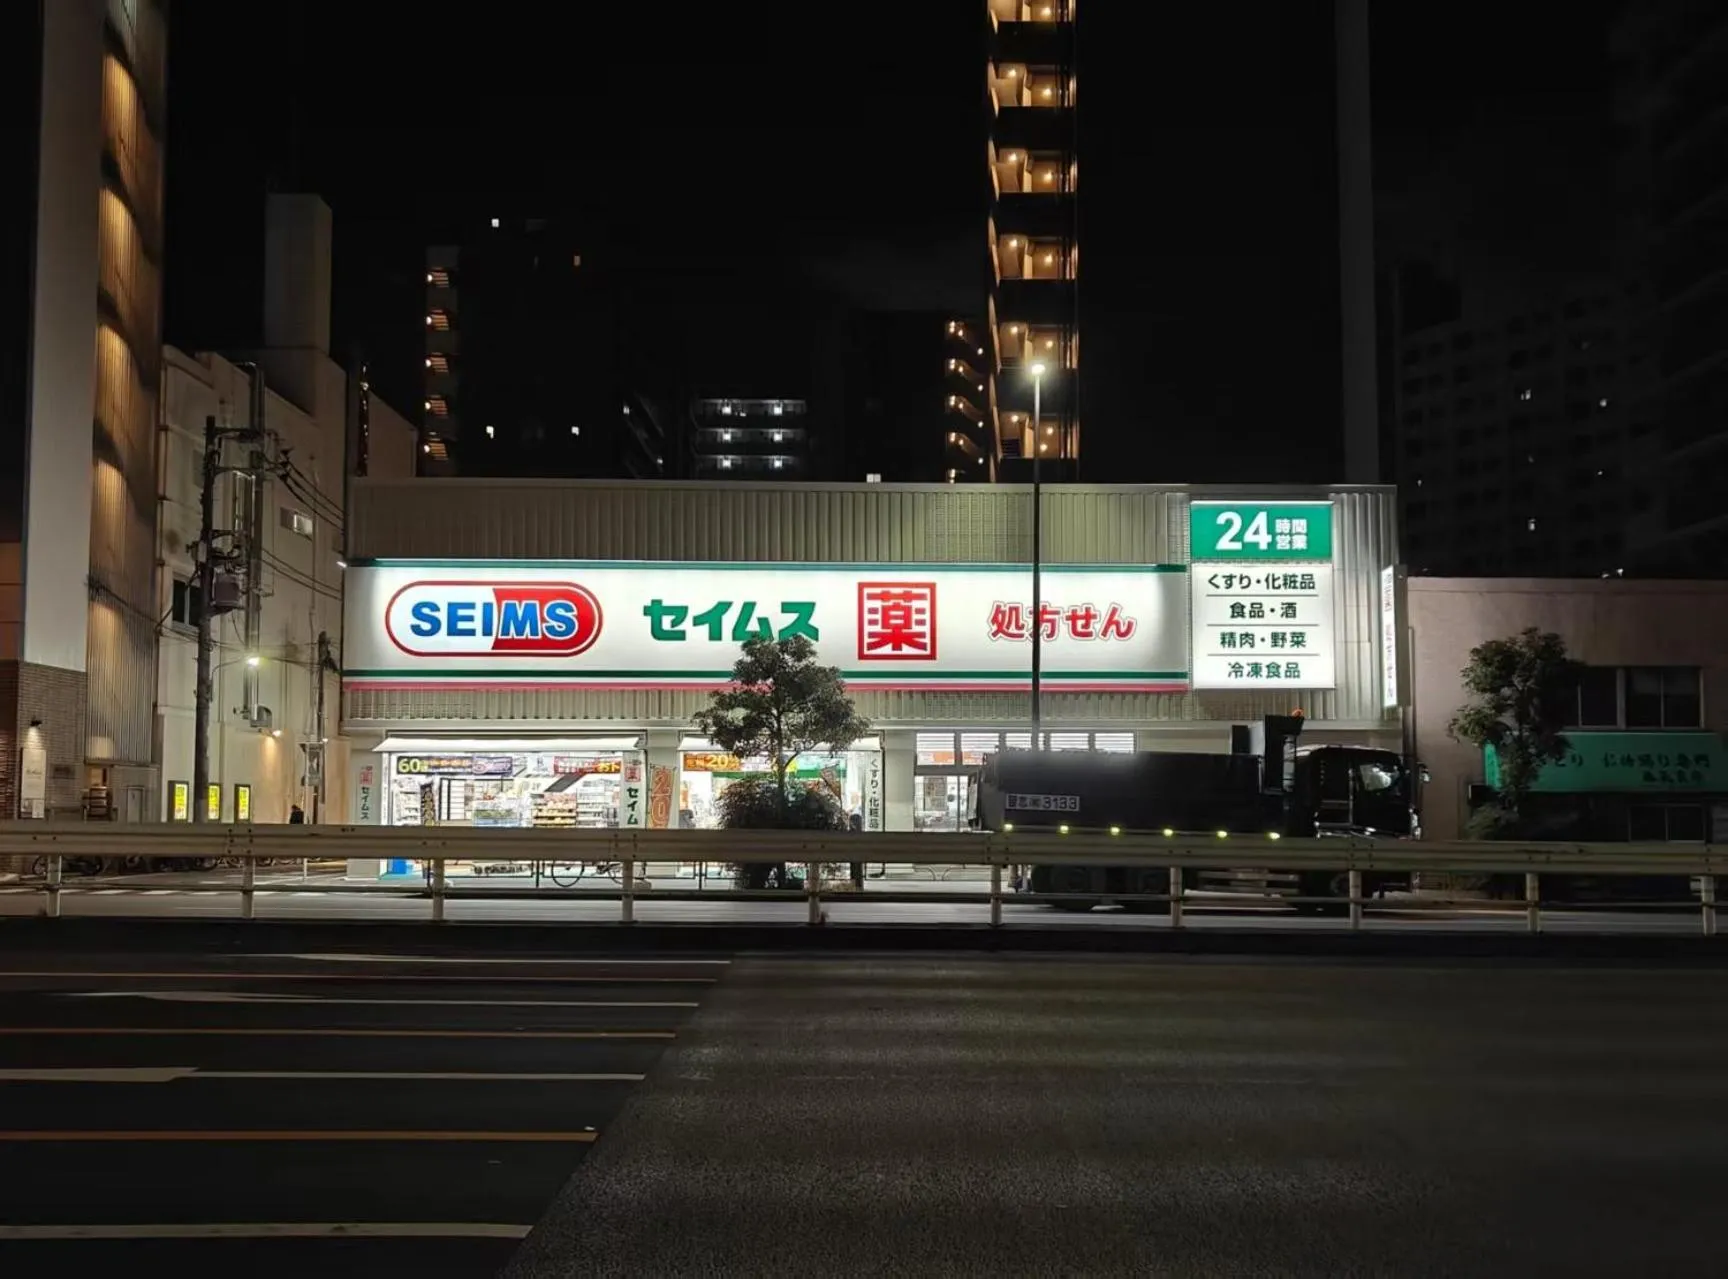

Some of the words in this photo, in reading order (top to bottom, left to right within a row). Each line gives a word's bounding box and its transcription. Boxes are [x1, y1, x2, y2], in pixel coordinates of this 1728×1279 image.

[1215, 511, 1272, 550] 24
[1275, 519, 1307, 534] 時間
[1275, 535, 1307, 550] 営業
[1207, 573, 1316, 590] くすり・化粧品
[410, 600, 578, 639] SEIMS
[1229, 602, 1298, 619] 食品・酒
[643, 598, 820, 643] セイムス
[864, 588, 930, 653] 薬
[989, 602, 1136, 639] 処方せん
[1219, 631, 1307, 649] 精肉・野菜
[1227, 661, 1301, 679] 冷凍食品
